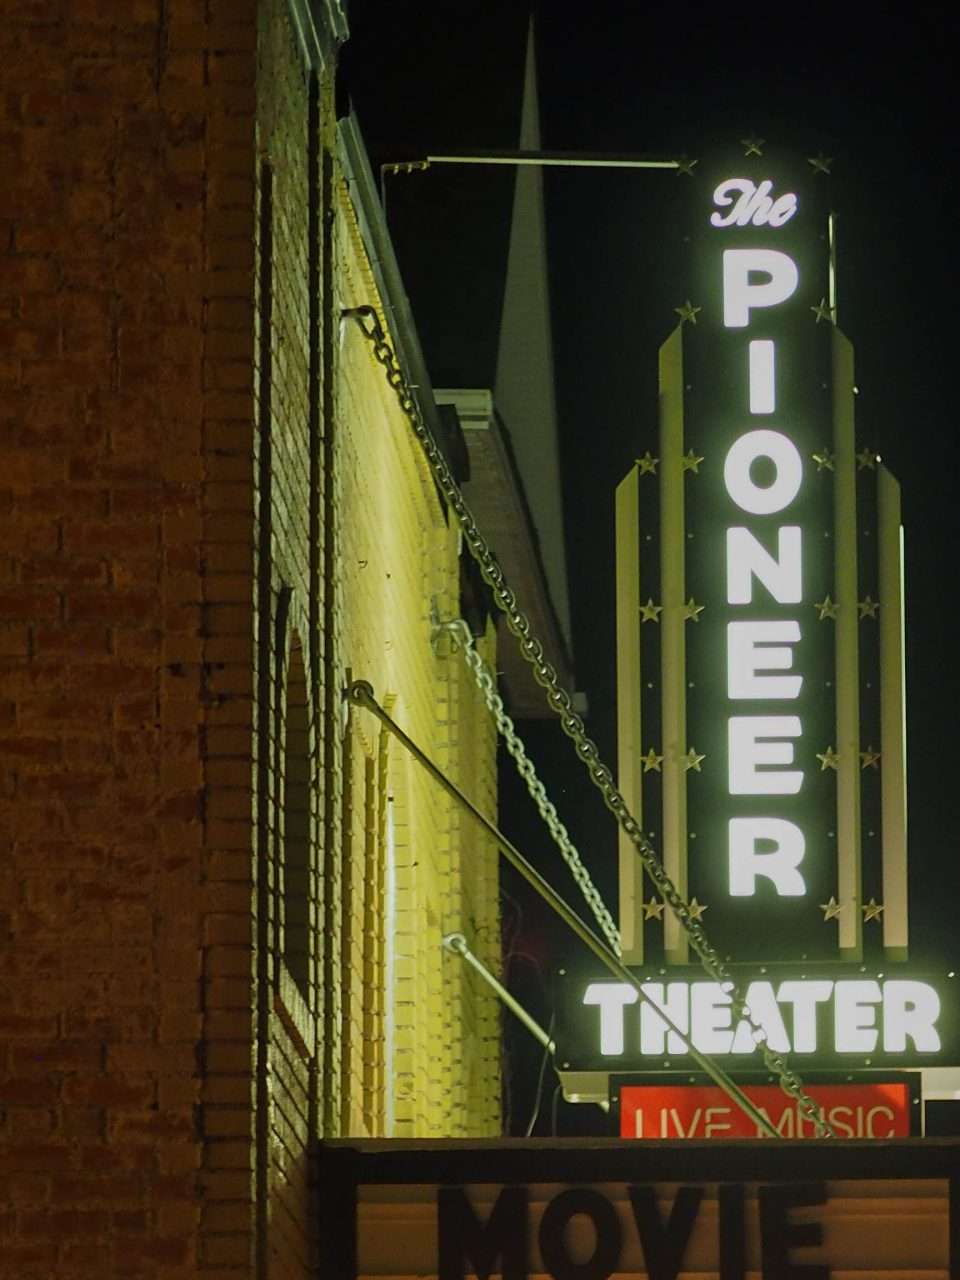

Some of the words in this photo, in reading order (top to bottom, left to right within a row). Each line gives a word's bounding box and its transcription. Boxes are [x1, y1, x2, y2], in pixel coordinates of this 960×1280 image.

[710, 178, 798, 227] The
[722, 248, 807, 897] PIONEER
[582, 980, 942, 1056] THEATER
[634, 1107, 731, 1138] LIVE
[757, 1105, 895, 1138] MUSIC
